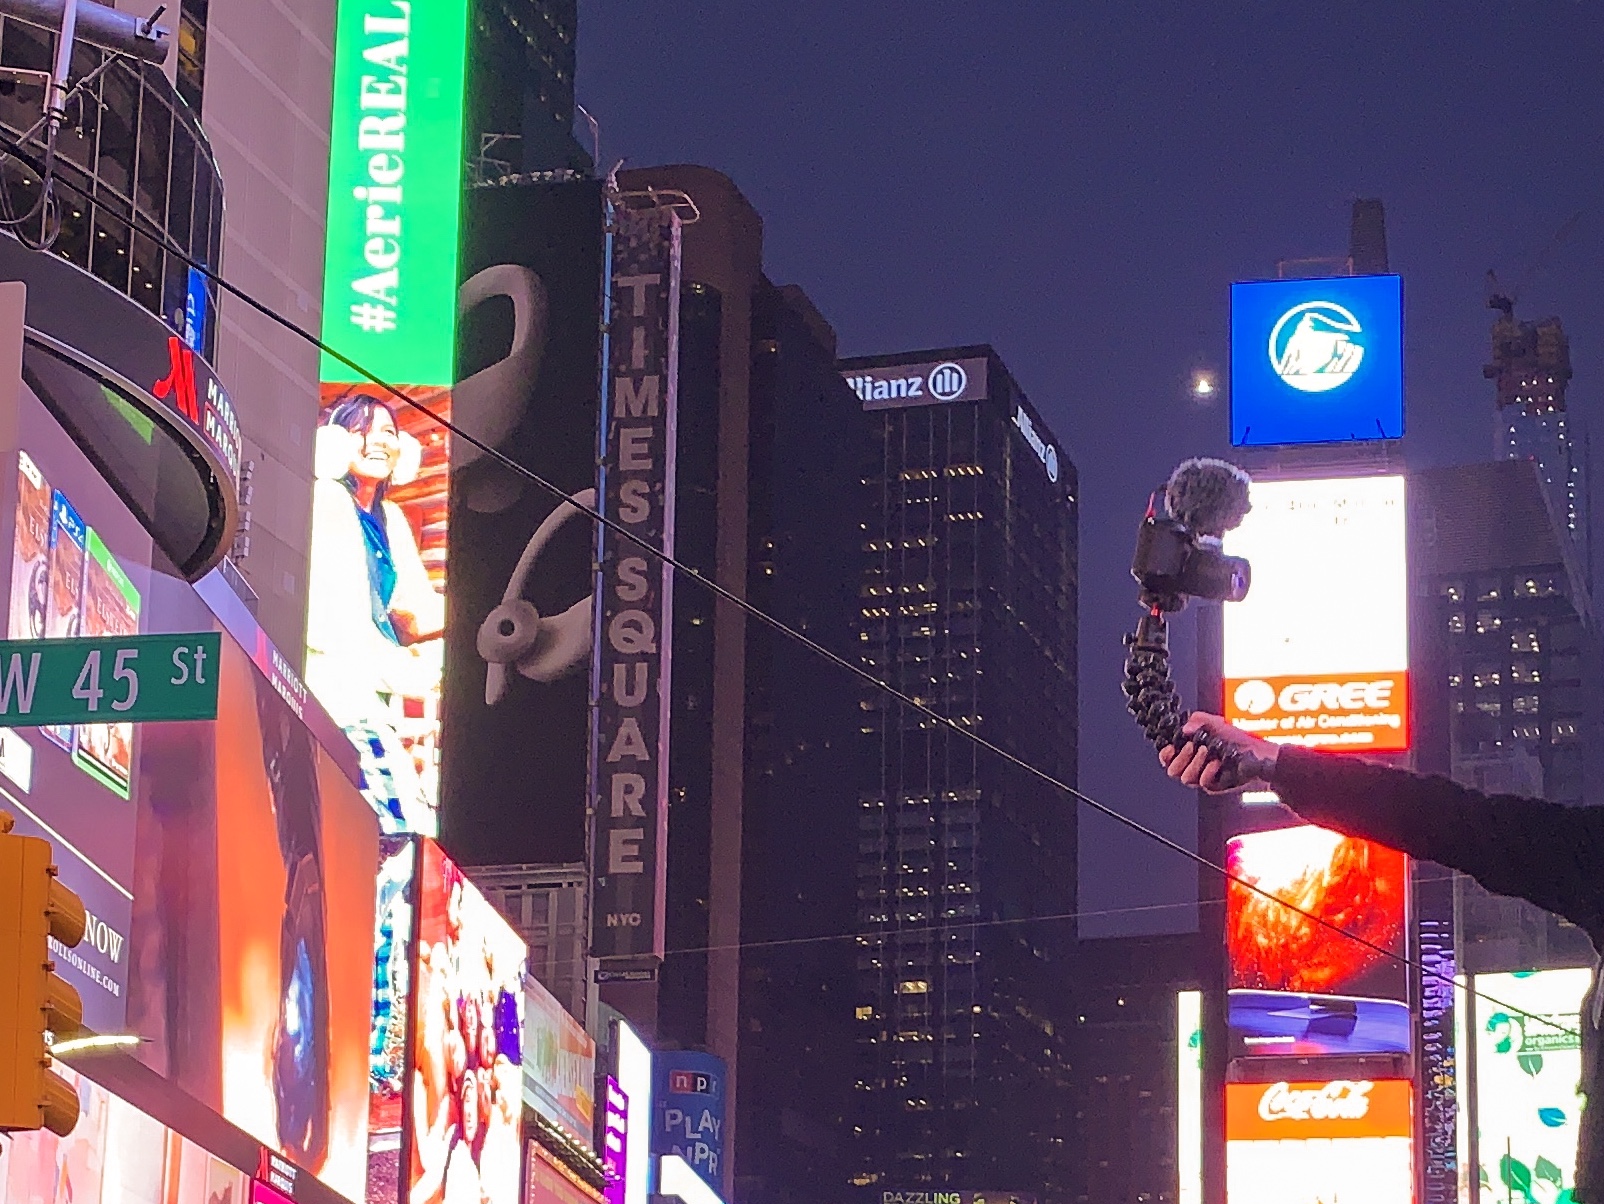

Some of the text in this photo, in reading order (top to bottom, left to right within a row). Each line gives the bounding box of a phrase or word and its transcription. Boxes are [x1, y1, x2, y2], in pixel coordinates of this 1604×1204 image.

[350, 0, 411, 333] #AerieREAL
[847, 376, 923, 400] lianz
[606, 273, 662, 875] TIMES SQUARE
[0, 645, 207, 714] W 45 St
[1278, 680, 1394, 712] GREE
[606, 912, 642, 928] NYC
[83, 909, 124, 964] NOW
[665, 1109, 720, 1141] PLAY
[883, 1192, 960, 1204] DAZZLING
